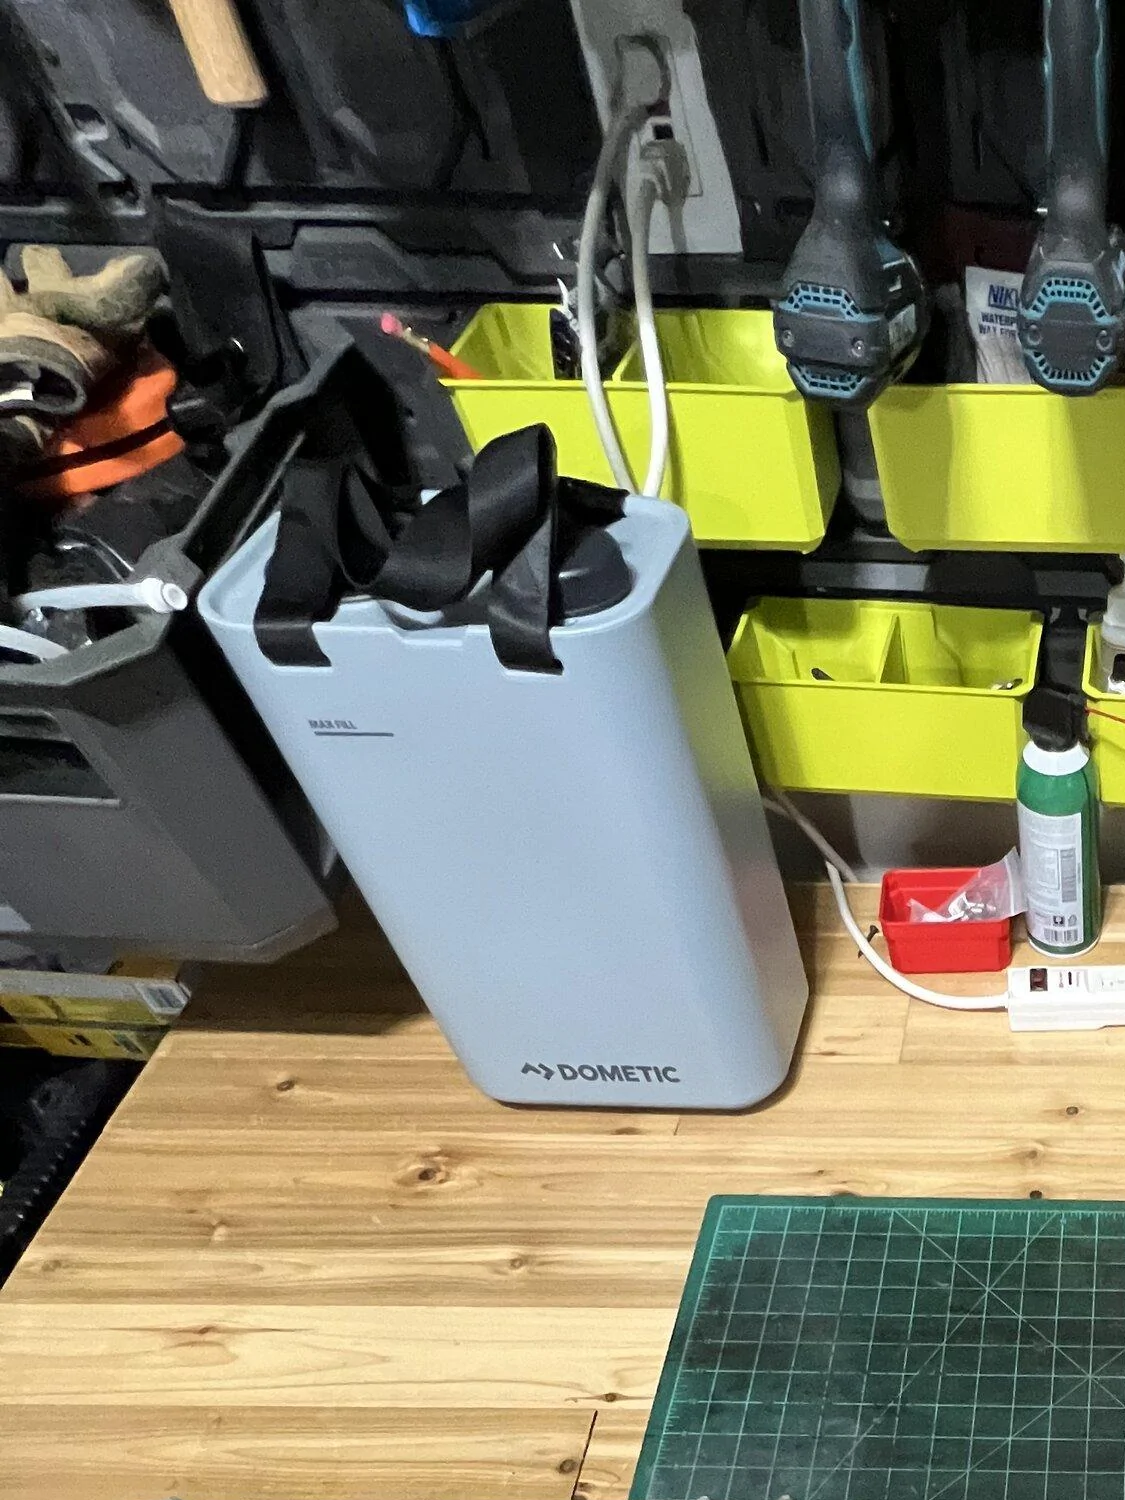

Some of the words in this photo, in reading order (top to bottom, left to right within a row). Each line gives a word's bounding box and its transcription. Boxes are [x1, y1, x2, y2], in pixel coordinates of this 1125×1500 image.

[988, 284, 1019, 307] NIK
[308, 719, 334, 729] MAX
[334, 719, 358, 729] FILL
[557, 1063, 681, 1083] DOMETIC
